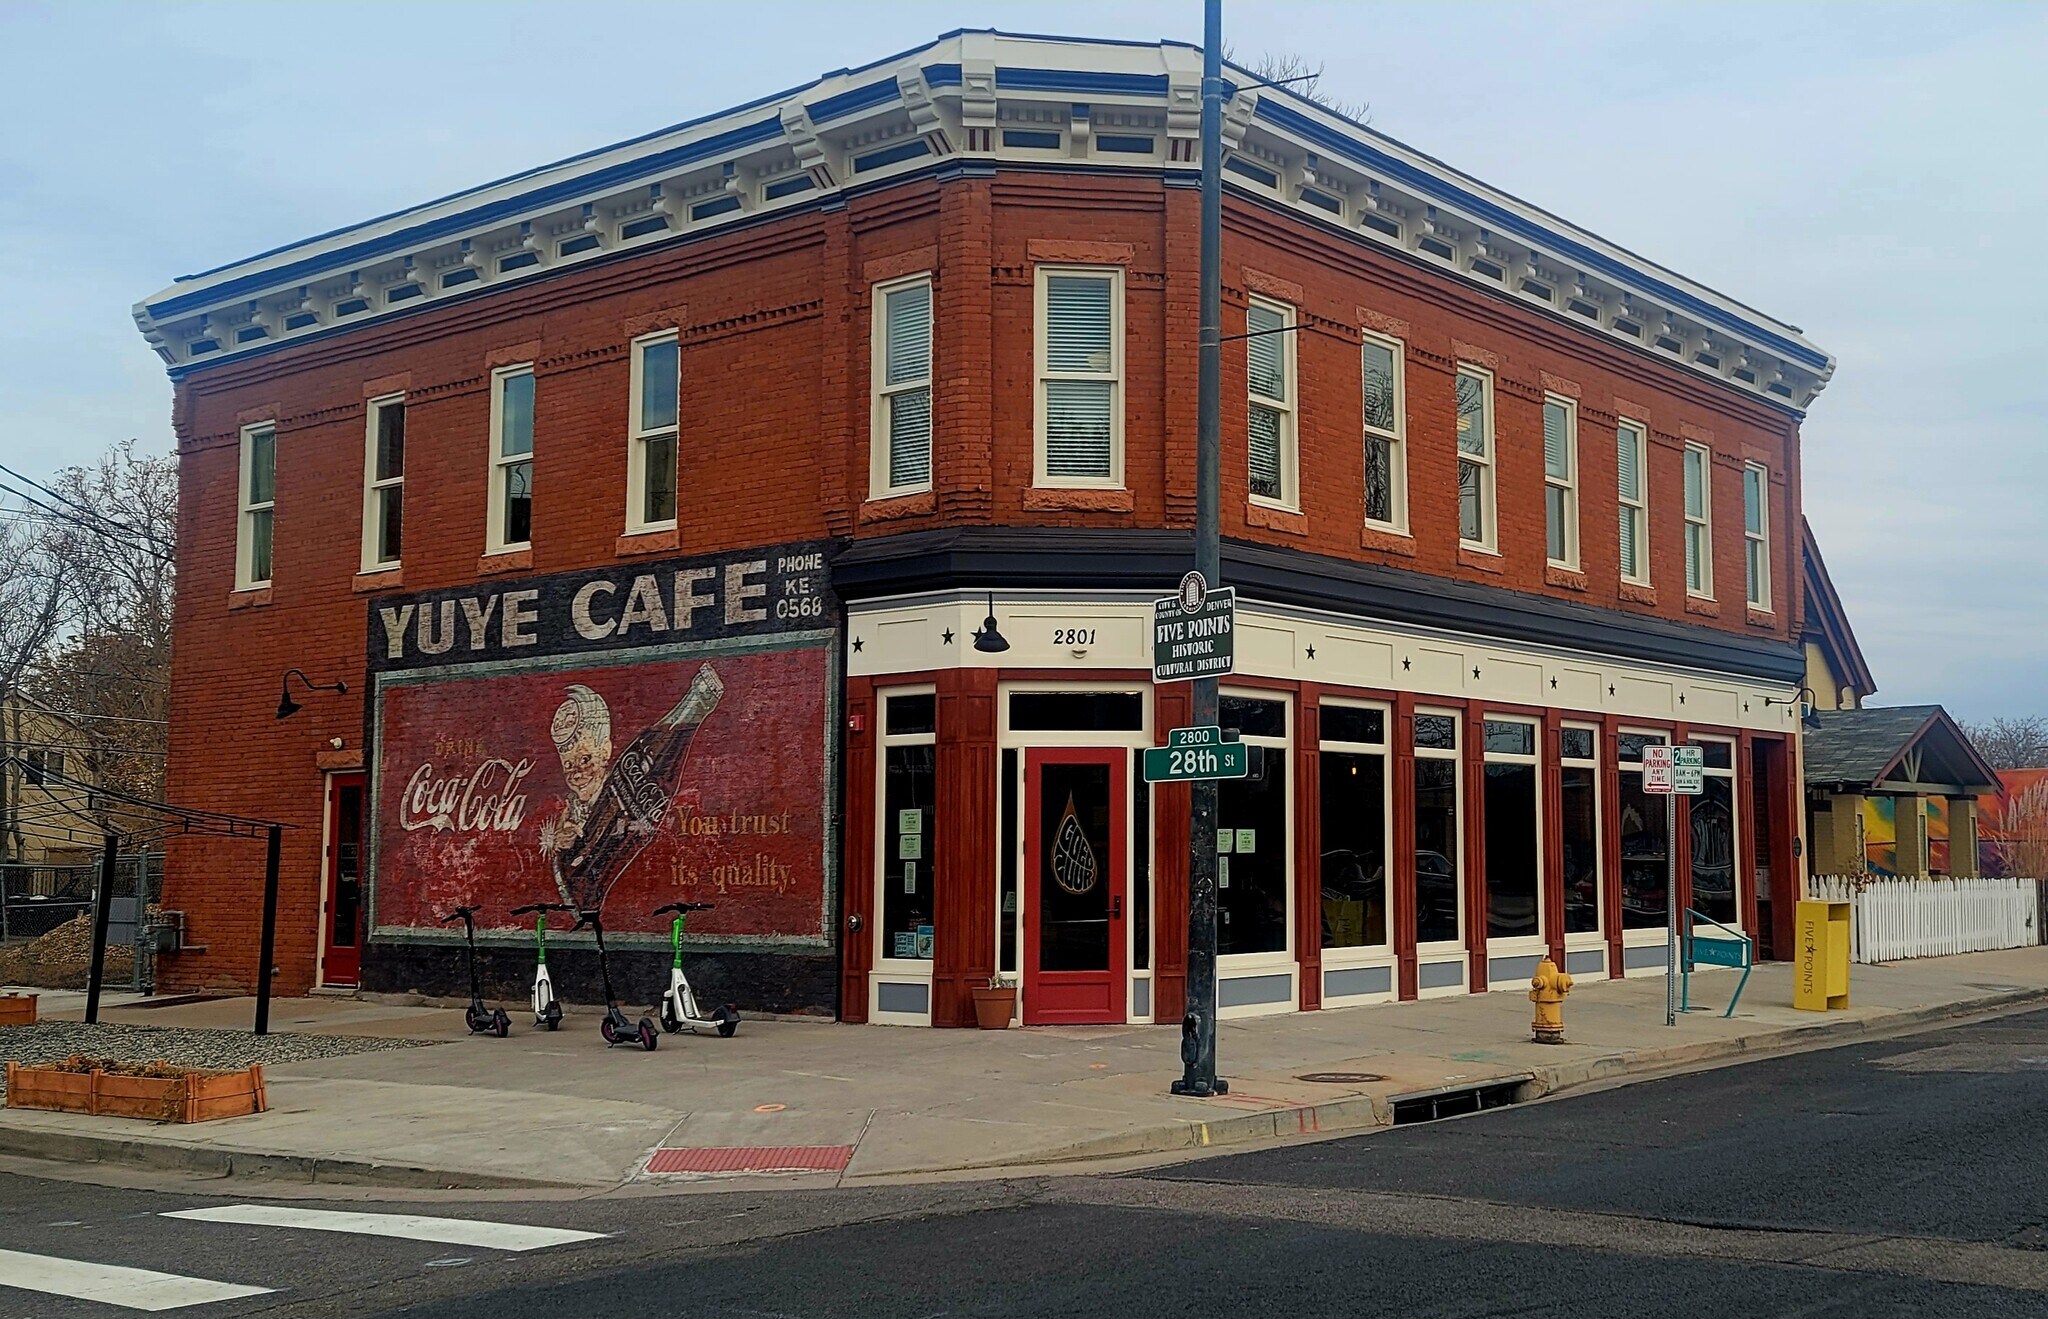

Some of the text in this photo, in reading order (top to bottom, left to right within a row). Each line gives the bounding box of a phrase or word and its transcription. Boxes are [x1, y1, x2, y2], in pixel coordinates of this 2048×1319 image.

[778, 553, 823, 574] PHONE
[379, 560, 768, 659] YUYE CAFE
[776, 597, 822, 619] 0568
[1206, 598, 1232, 611] DENVER
[1053, 628, 1096, 645] 2801
[1156, 614, 1231, 643] FIVE POINTS
[1172, 639, 1215, 658] HISTORIC
[1156, 655, 1231, 676] CULTURAL DISTRICT
[1180, 730, 1210, 744] 2800
[1169, 749, 1235, 774] 28th St
[1645, 759, 1671, 768] PARKING
[1652, 749, 1664, 758] NO
[1674, 750, 1680, 764] 2
[1680, 757, 1702, 765] PARKING
[400, 758, 537, 832] Coca-Cola
[674, 805, 791, 838] You trust
[671, 852, 797, 895] its quality.
[1803, 920, 1815, 995] FIVE POINTS
